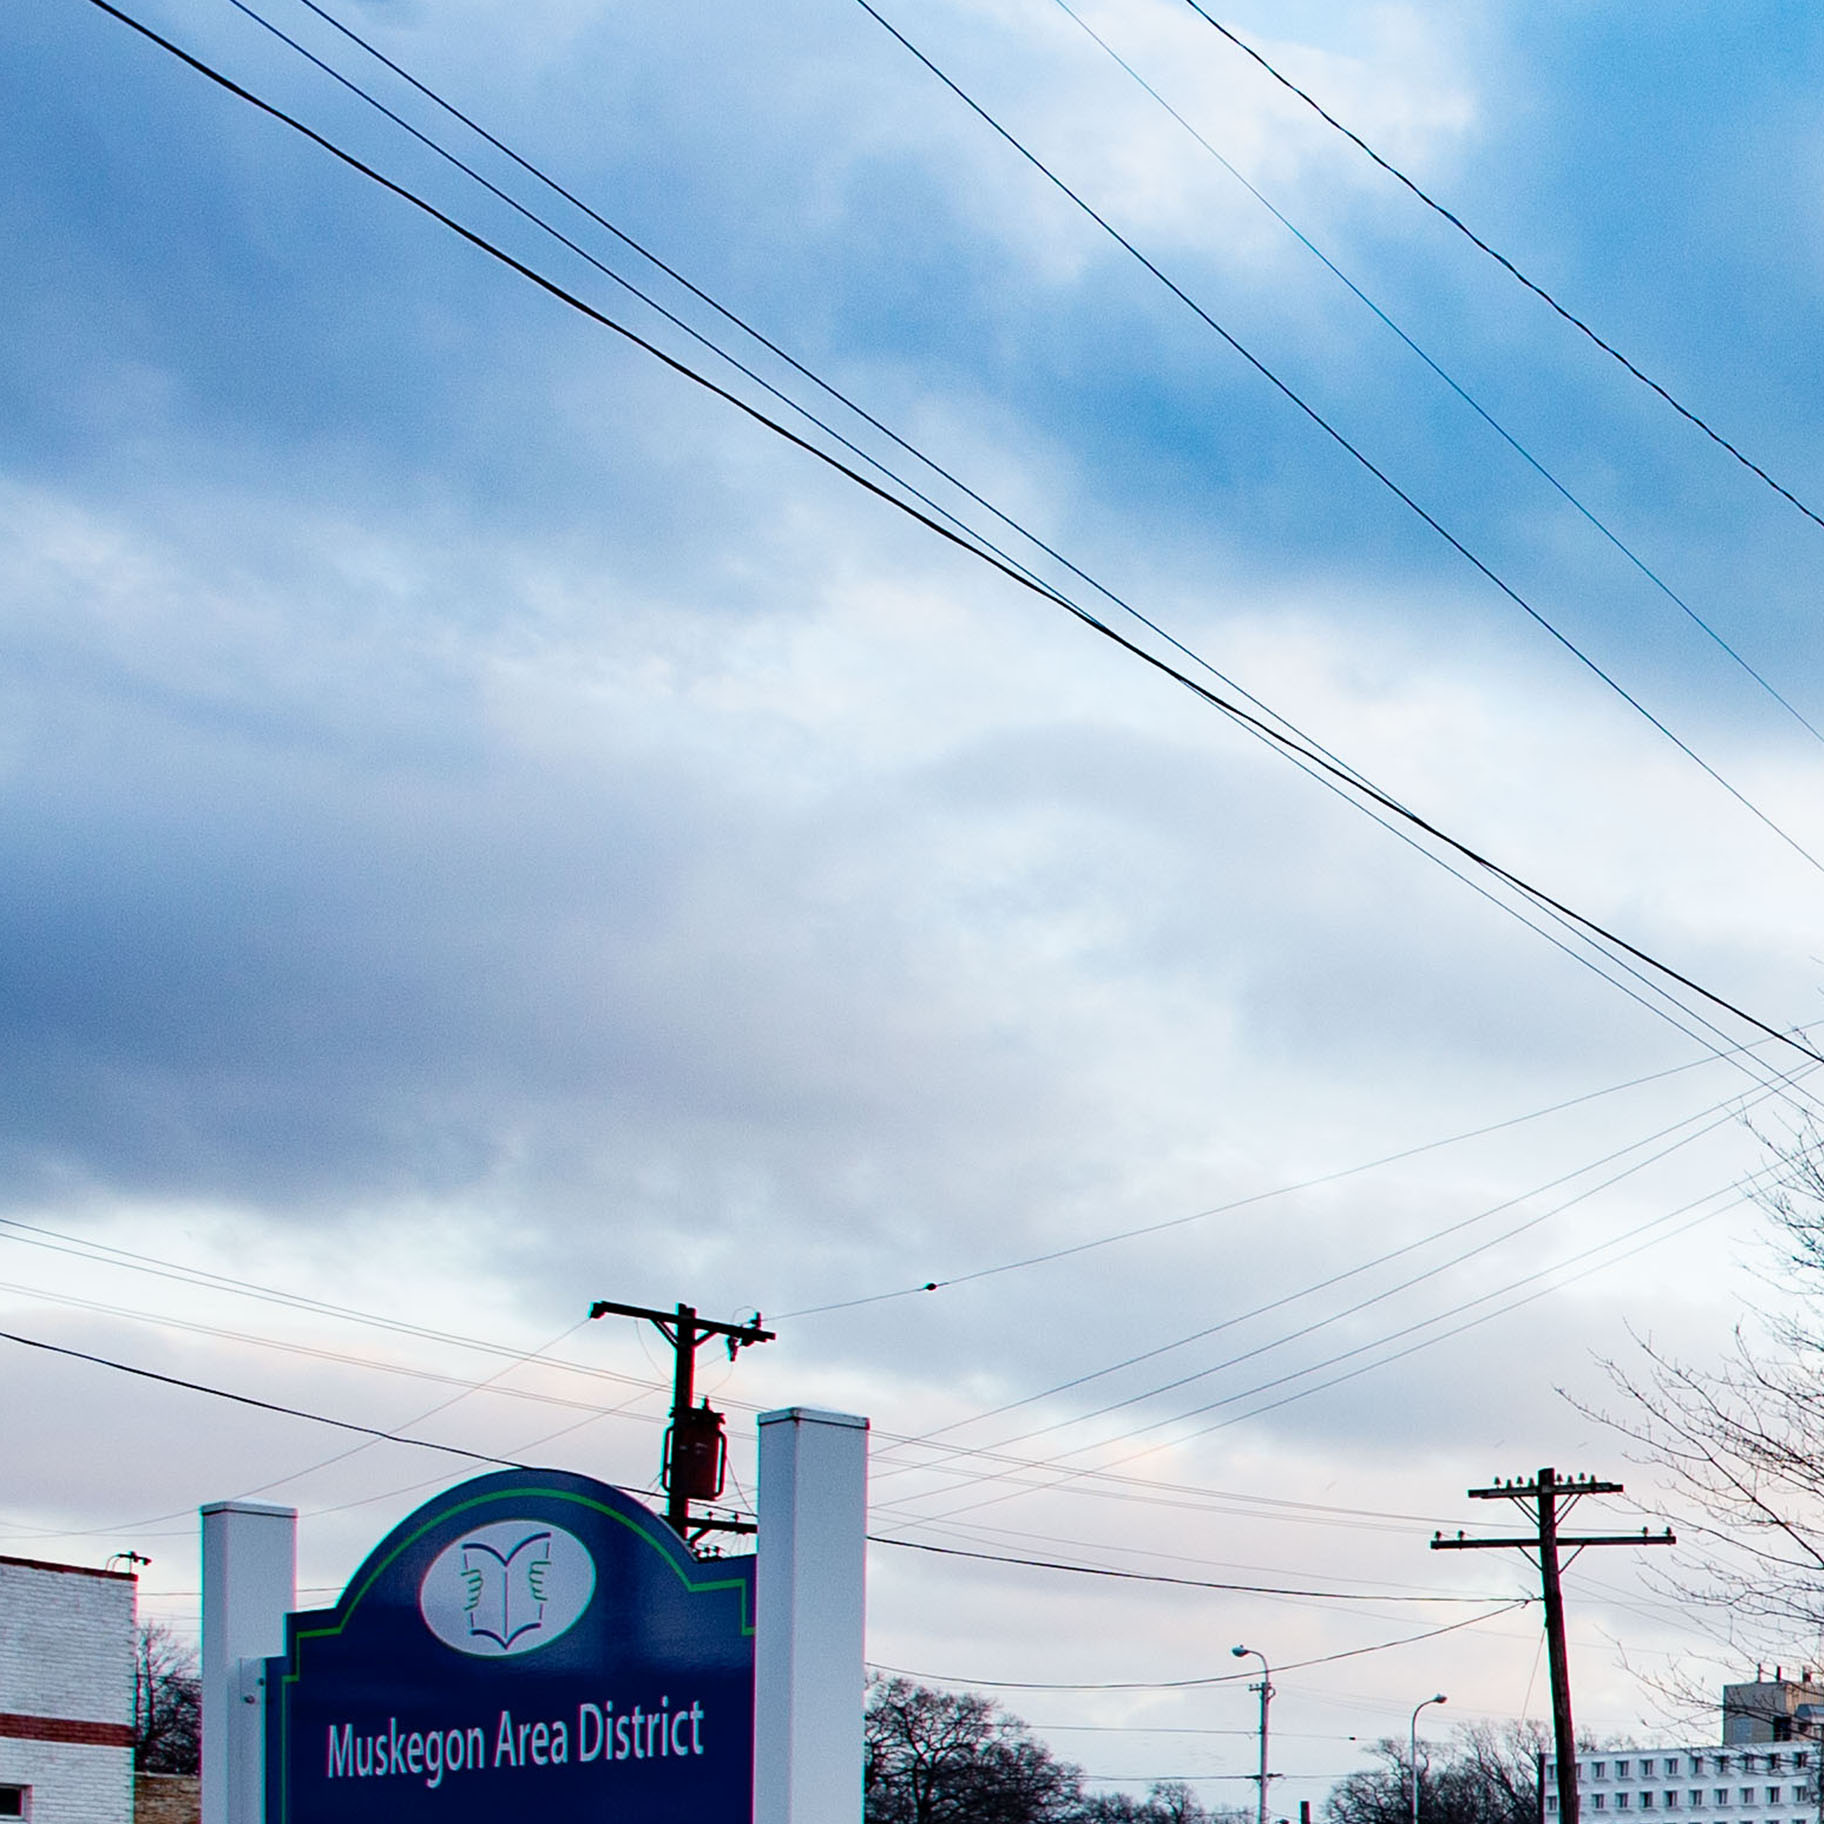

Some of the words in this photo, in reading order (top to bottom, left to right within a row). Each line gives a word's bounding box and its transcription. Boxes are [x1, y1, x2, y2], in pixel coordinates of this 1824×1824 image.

[326, 1717, 485, 1788] Muskegon
[494, 1711, 568, 1767] Area
[578, 1695, 704, 1762] District
